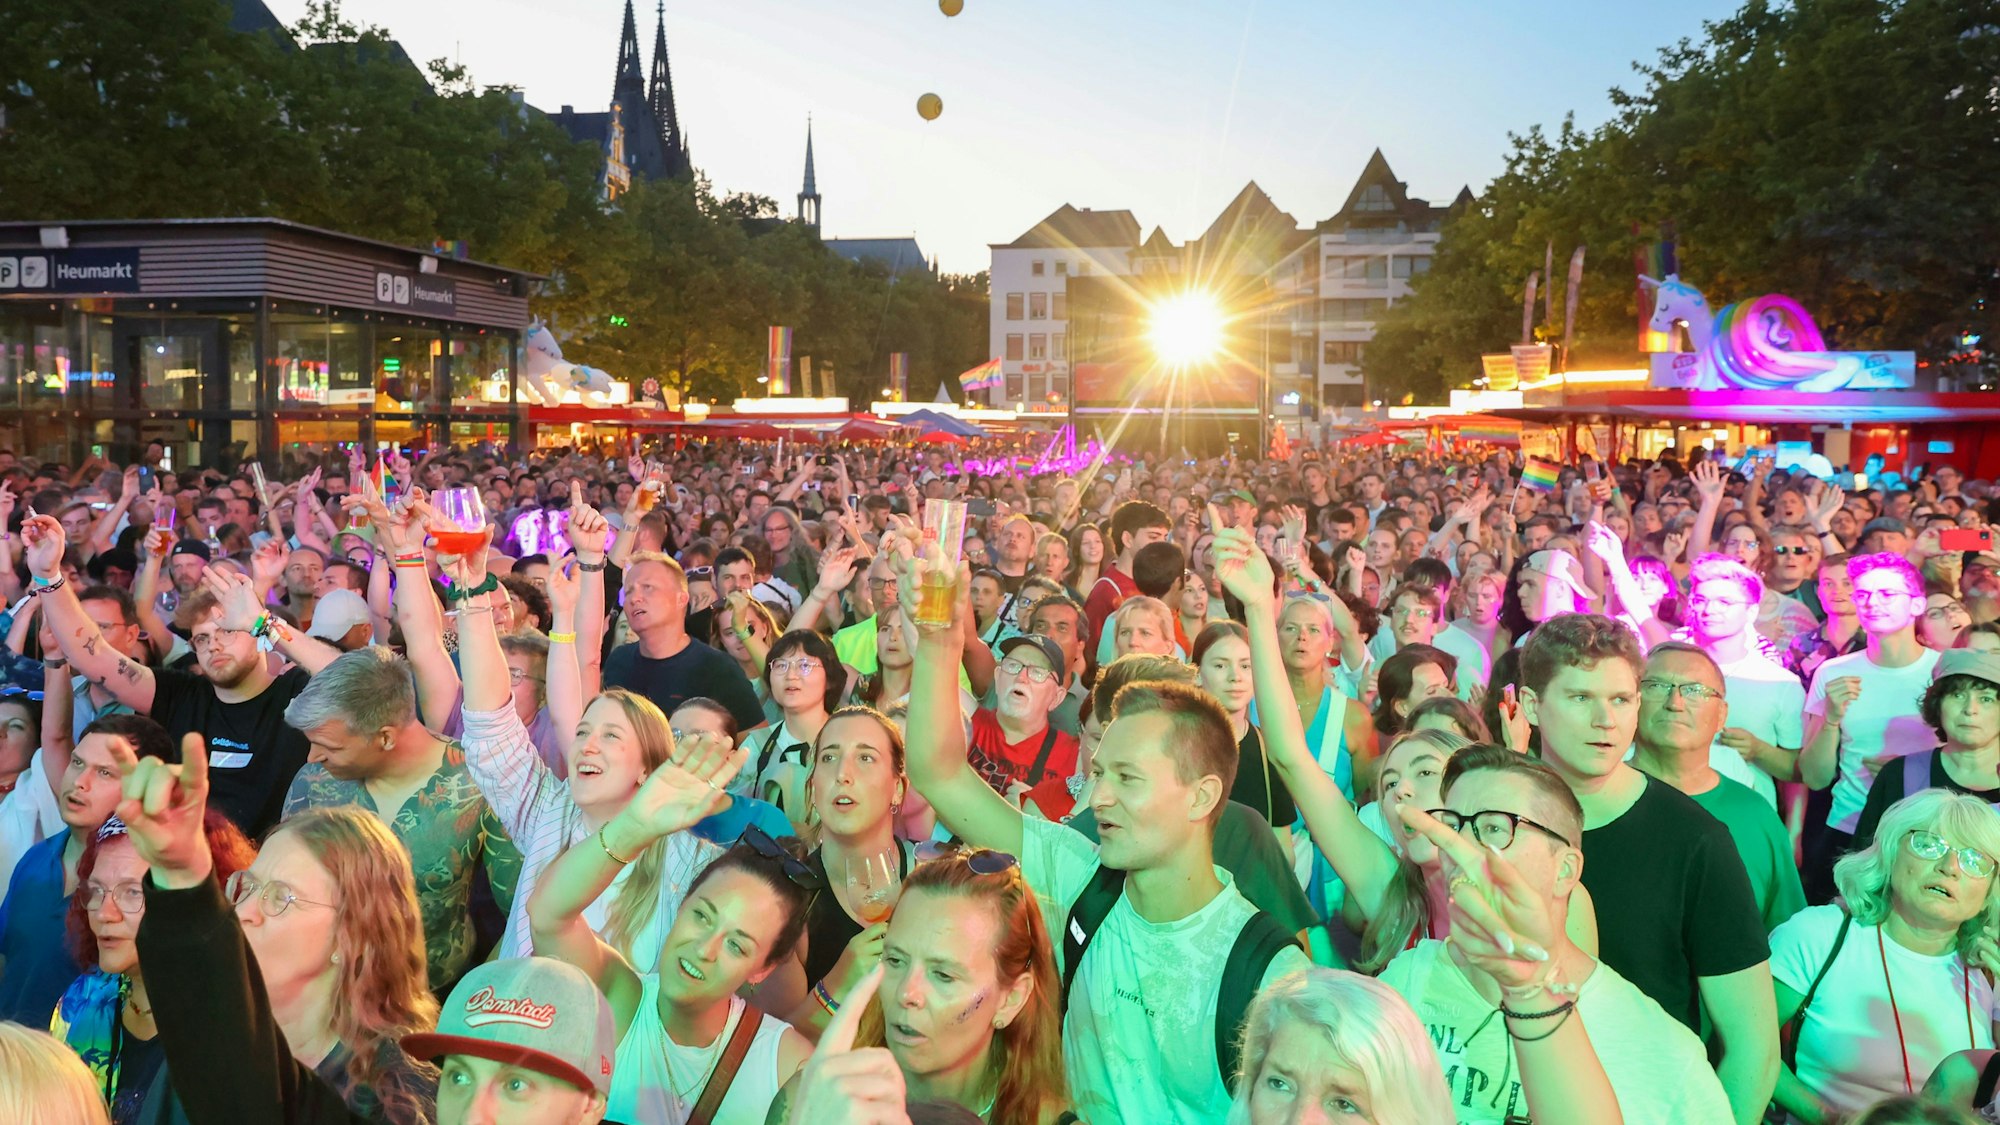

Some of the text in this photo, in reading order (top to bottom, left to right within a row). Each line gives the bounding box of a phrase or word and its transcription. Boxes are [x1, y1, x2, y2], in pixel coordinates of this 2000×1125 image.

[57, 262, 132, 279] Heumarkt
[414, 286, 453, 304] Heumarkt
[465, 985, 557, 1022] Domstadt
